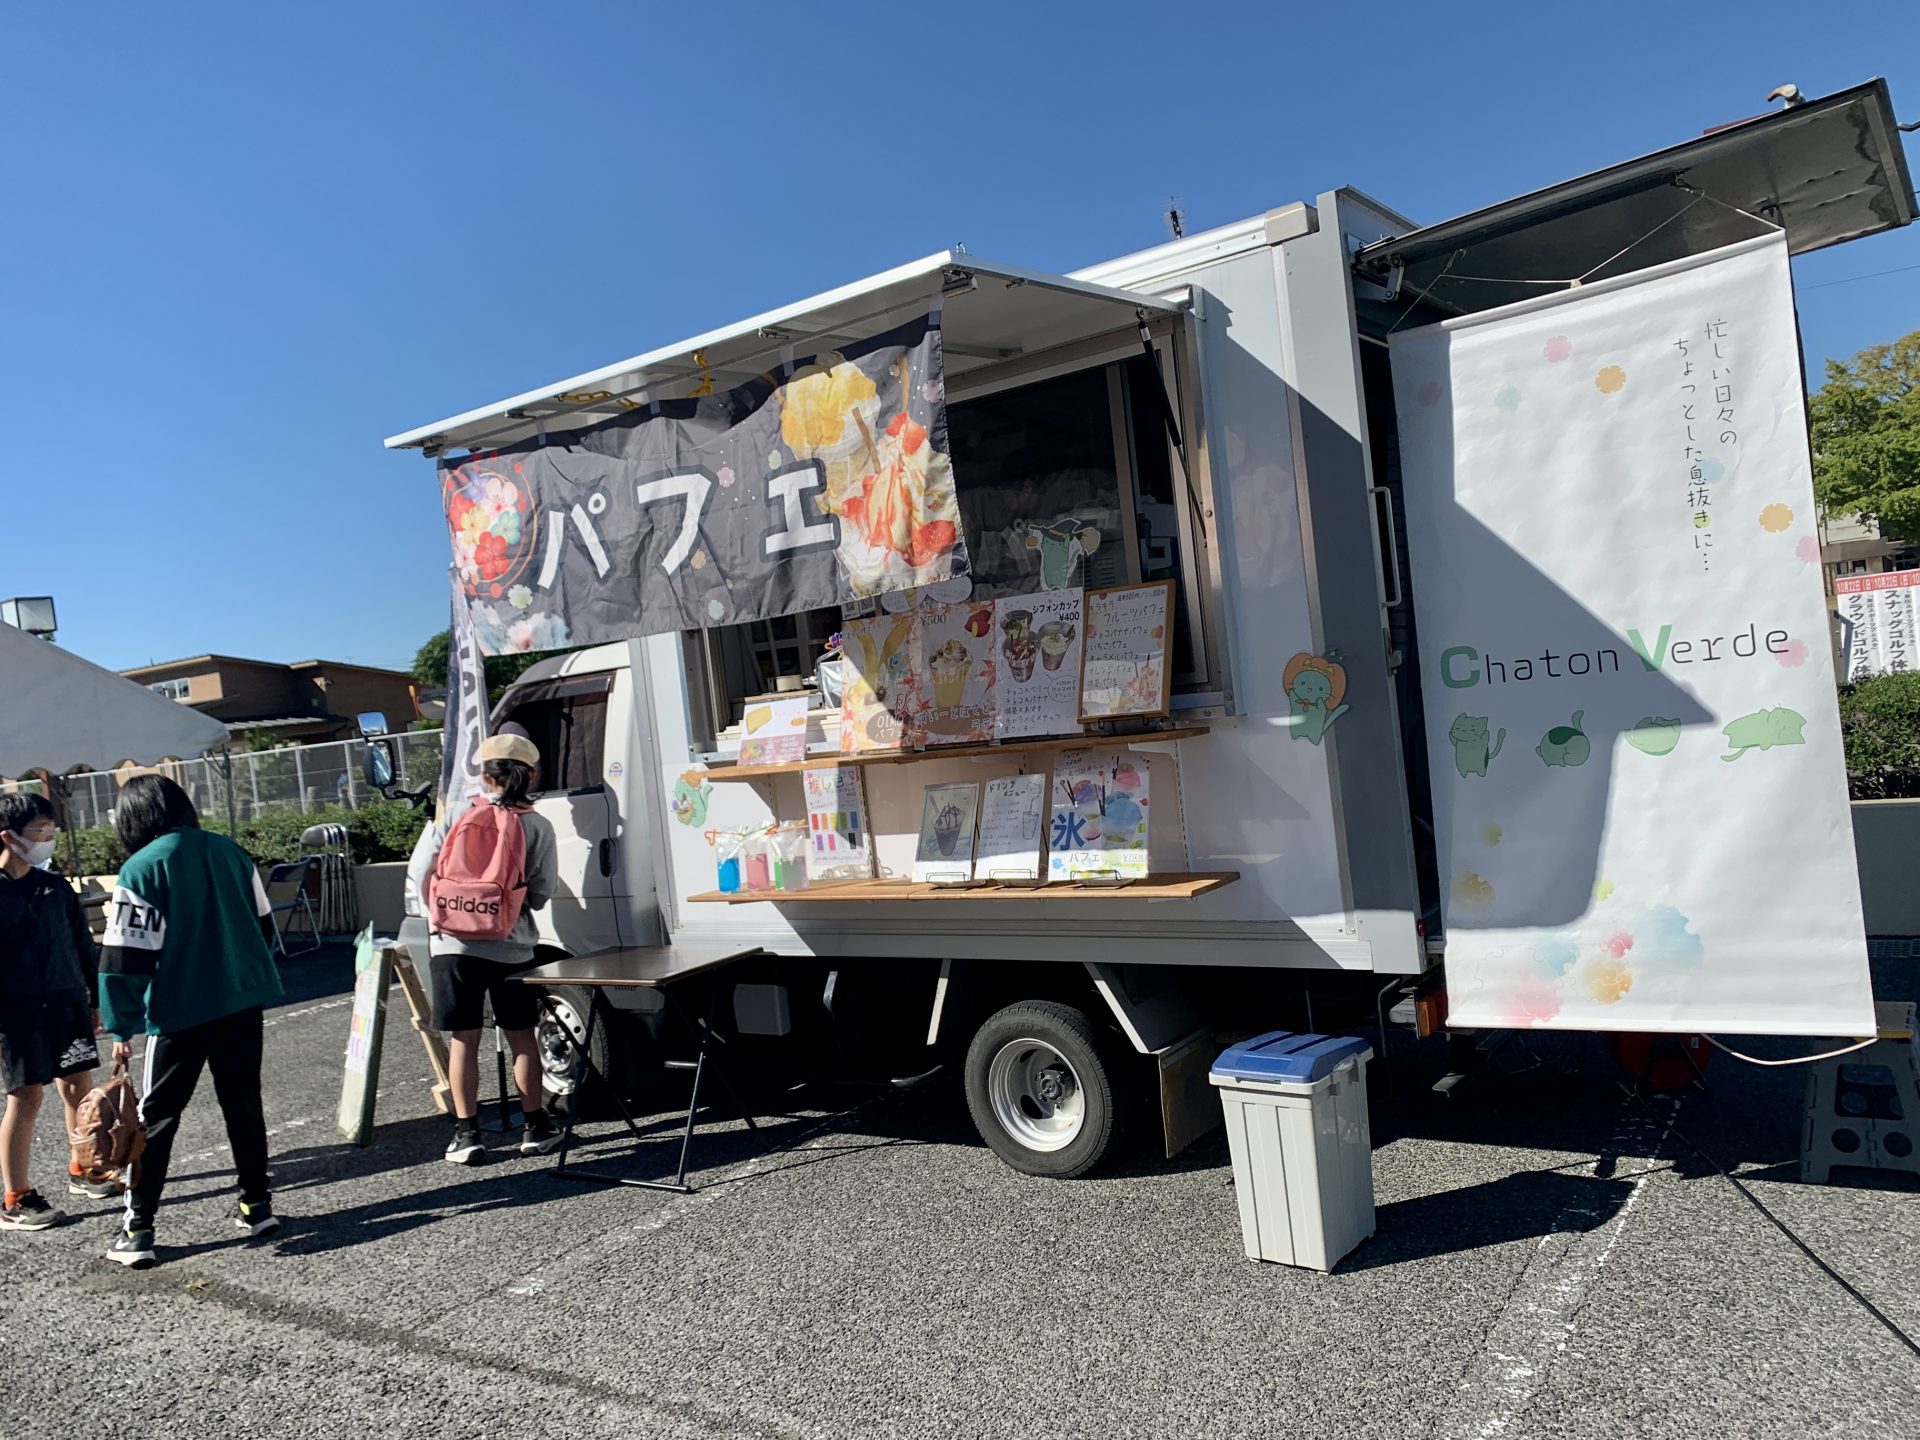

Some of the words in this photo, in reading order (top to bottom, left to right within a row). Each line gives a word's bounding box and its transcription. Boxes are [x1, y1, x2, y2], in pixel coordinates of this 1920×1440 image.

[1704, 318, 1737, 446] 忙しい日々の
[537, 466, 835, 589] パフェ
[1032, 599, 1080, 614] シフォンカップ
[1059, 611, 1080, 622] ¥400
[1104, 603, 1165, 623] フルーツパフェ
[1440, 645, 1619, 690] Chaton
[1626, 622, 1790, 673] Verde
[1052, 811, 1087, 851] 氷
[436, 895, 501, 916] adidas
